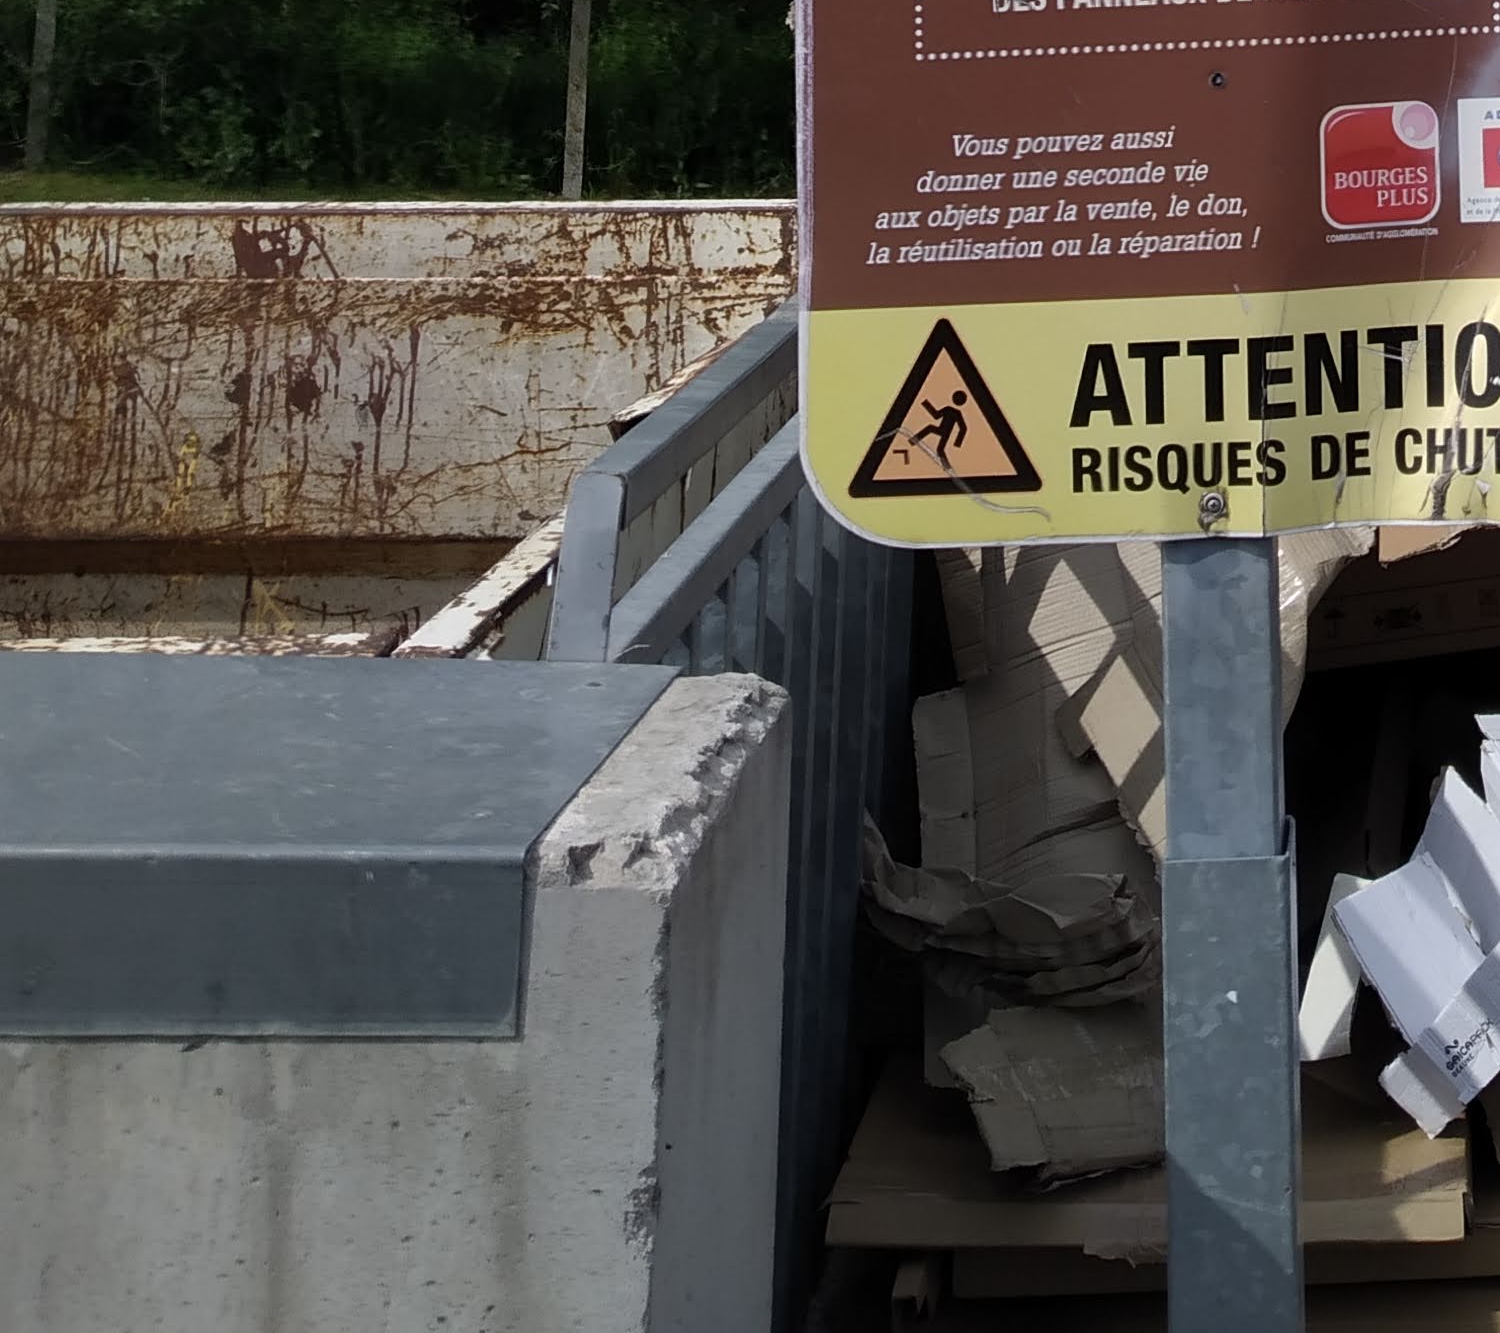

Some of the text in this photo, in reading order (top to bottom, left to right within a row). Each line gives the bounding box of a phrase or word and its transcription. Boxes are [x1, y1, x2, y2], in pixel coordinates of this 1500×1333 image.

[953, 126, 1175, 159] Vous pouvez aussi
[917, 159, 1208, 192] donner une seconde vie
[1335, 167, 1428, 194] BOURGES
[876, 194, 1247, 231] aux objets par la vente, le don,
[1378, 187, 1428, 207] PLUS
[866, 242, 889, 264] la
[897, 237, 1043, 263] réutilisation
[1052, 240, 1081, 256] ou
[1088, 233, 1111, 255] la
[1118, 228, 1242, 258] réparation
[1072, 439, 1287, 495] RISQUES
[1311, 433, 1372, 478] DE
